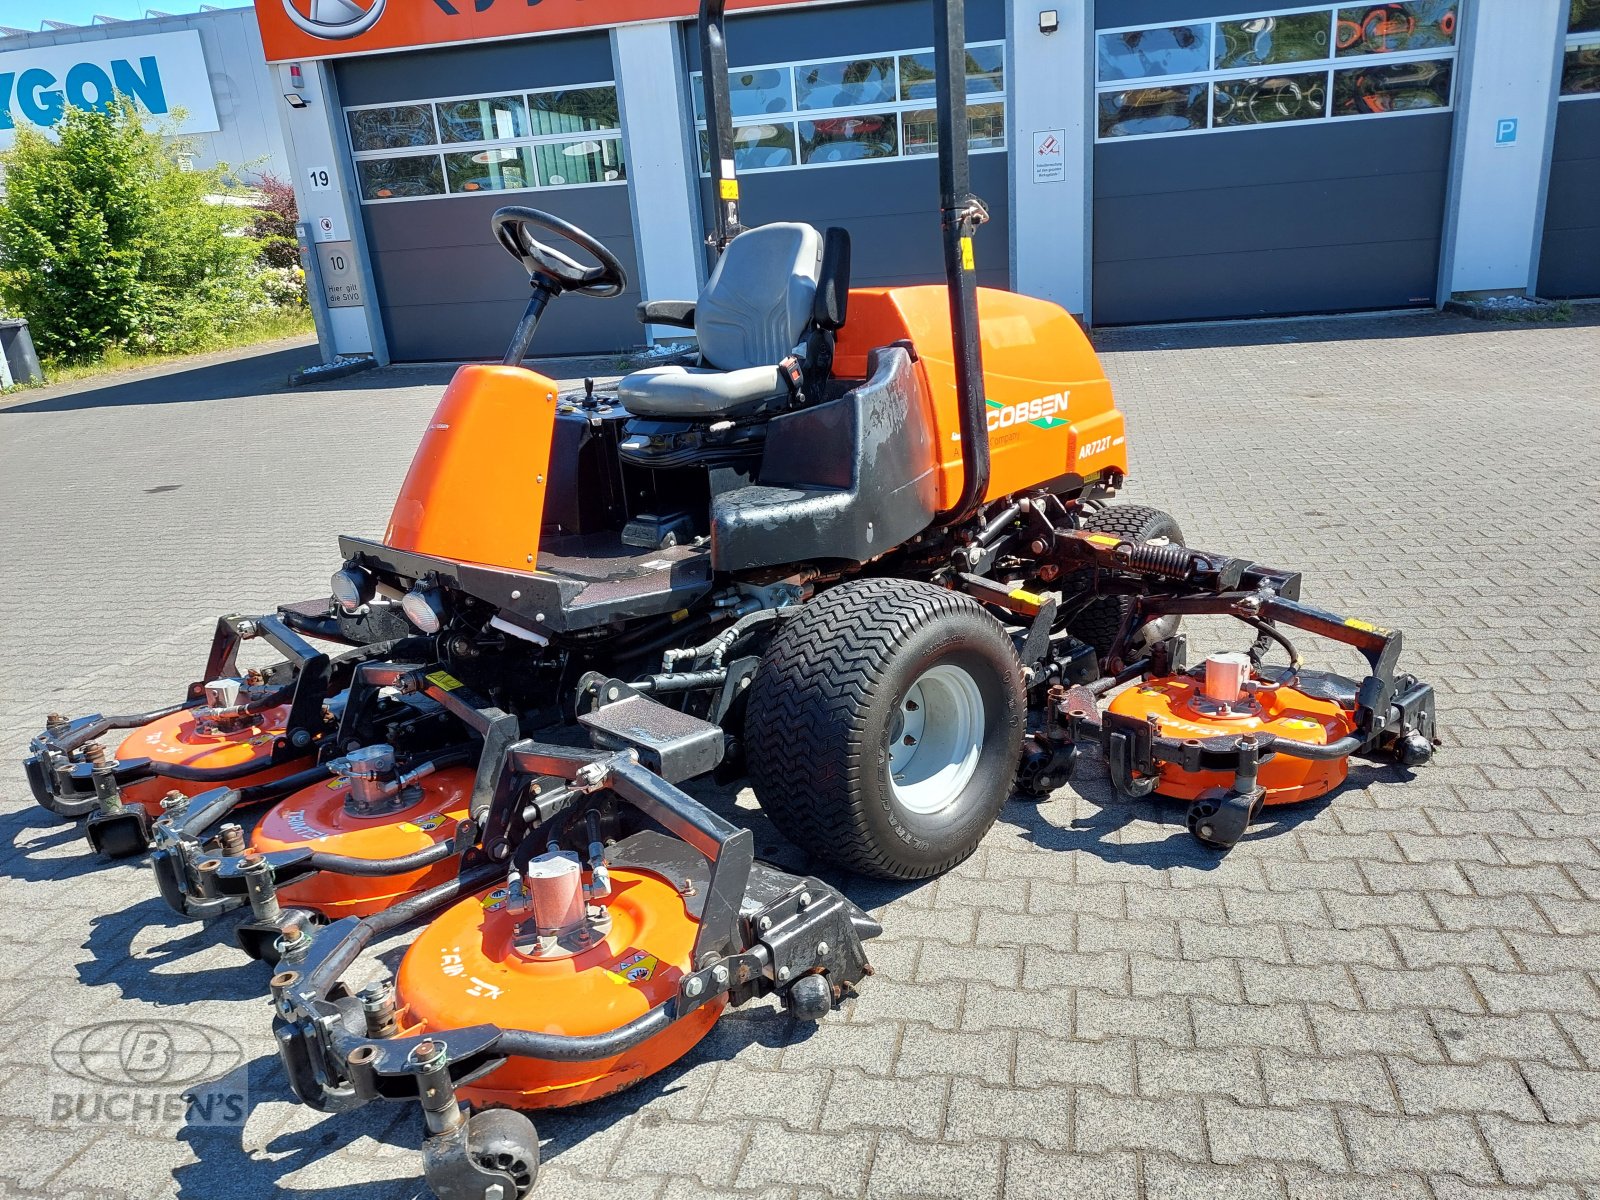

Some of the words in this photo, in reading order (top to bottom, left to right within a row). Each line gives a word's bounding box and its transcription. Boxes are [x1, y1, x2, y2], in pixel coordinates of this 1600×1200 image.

[1498, 121, 1514, 140] P
[310, 170, 329, 187] 19
[330, 256, 345, 271] 10
[328, 285, 342, 293] Hier
[346, 284, 358, 293] gilt
[330, 294, 341, 302] die
[343, 293, 360, 301] StVO
[951, 391, 1071, 441] COBSEN
[990, 431, 1021, 447] Company
[1078, 435, 1112, 460] AR722T
